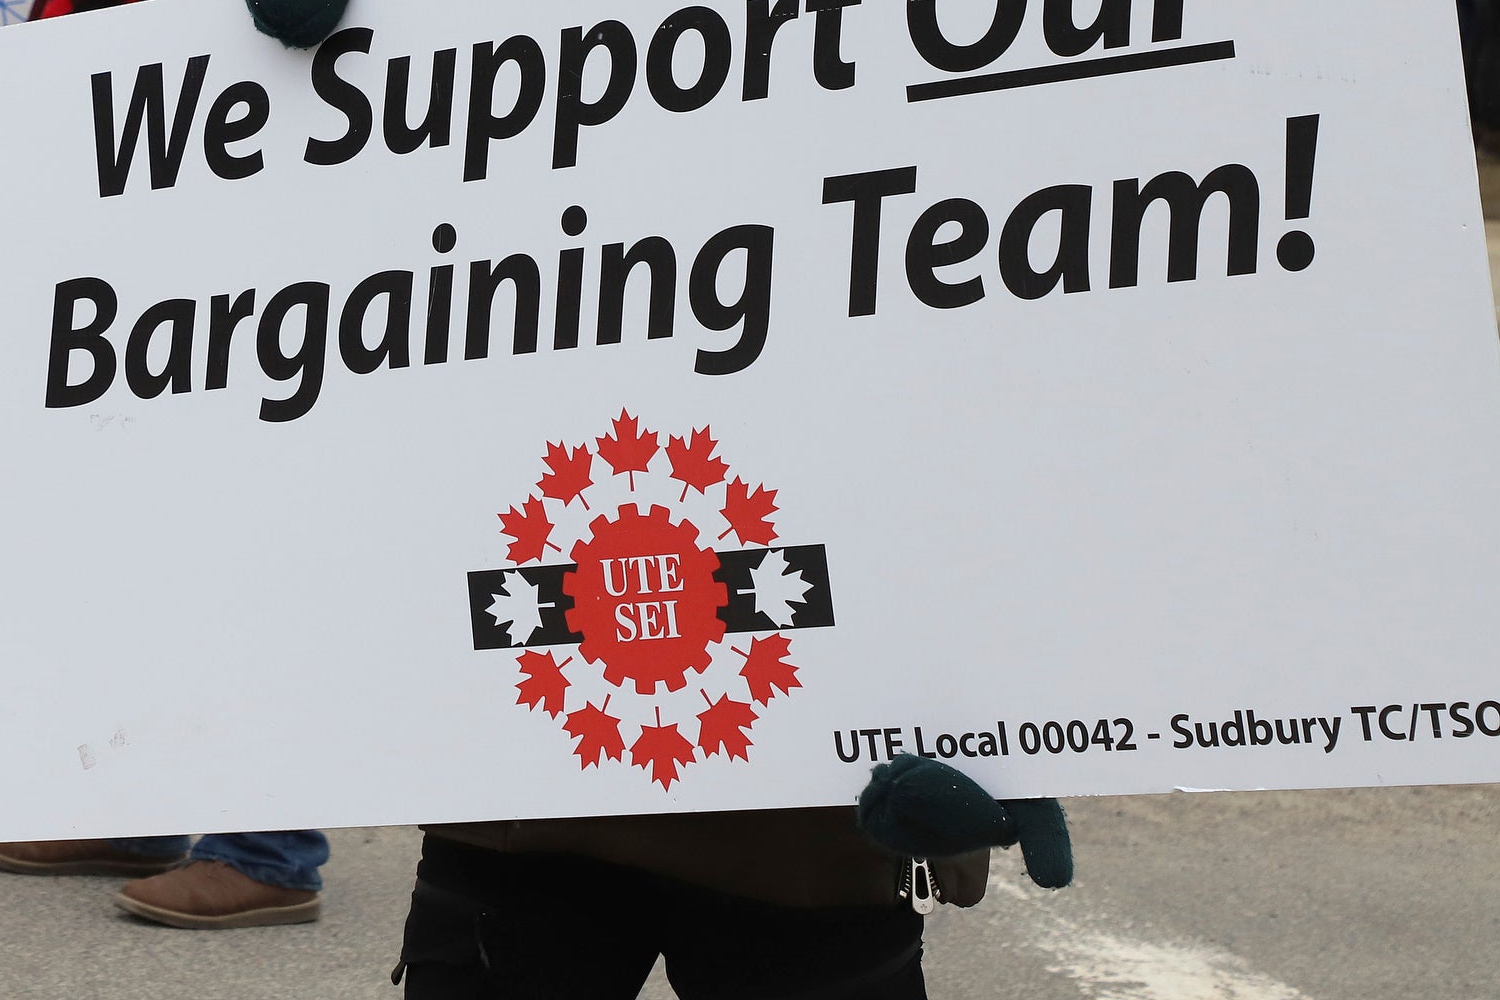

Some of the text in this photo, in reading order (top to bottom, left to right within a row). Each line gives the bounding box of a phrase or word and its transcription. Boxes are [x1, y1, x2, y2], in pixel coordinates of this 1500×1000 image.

[90, 54, 271, 198] We
[44, 113, 1321, 423] Bargaining Team!
[600, 553, 686, 598] UTE
[613, 600, 683, 644] SEI
[833, 700, 1500, 763] UTE Local 00042 - Sudbury TC/TSO
